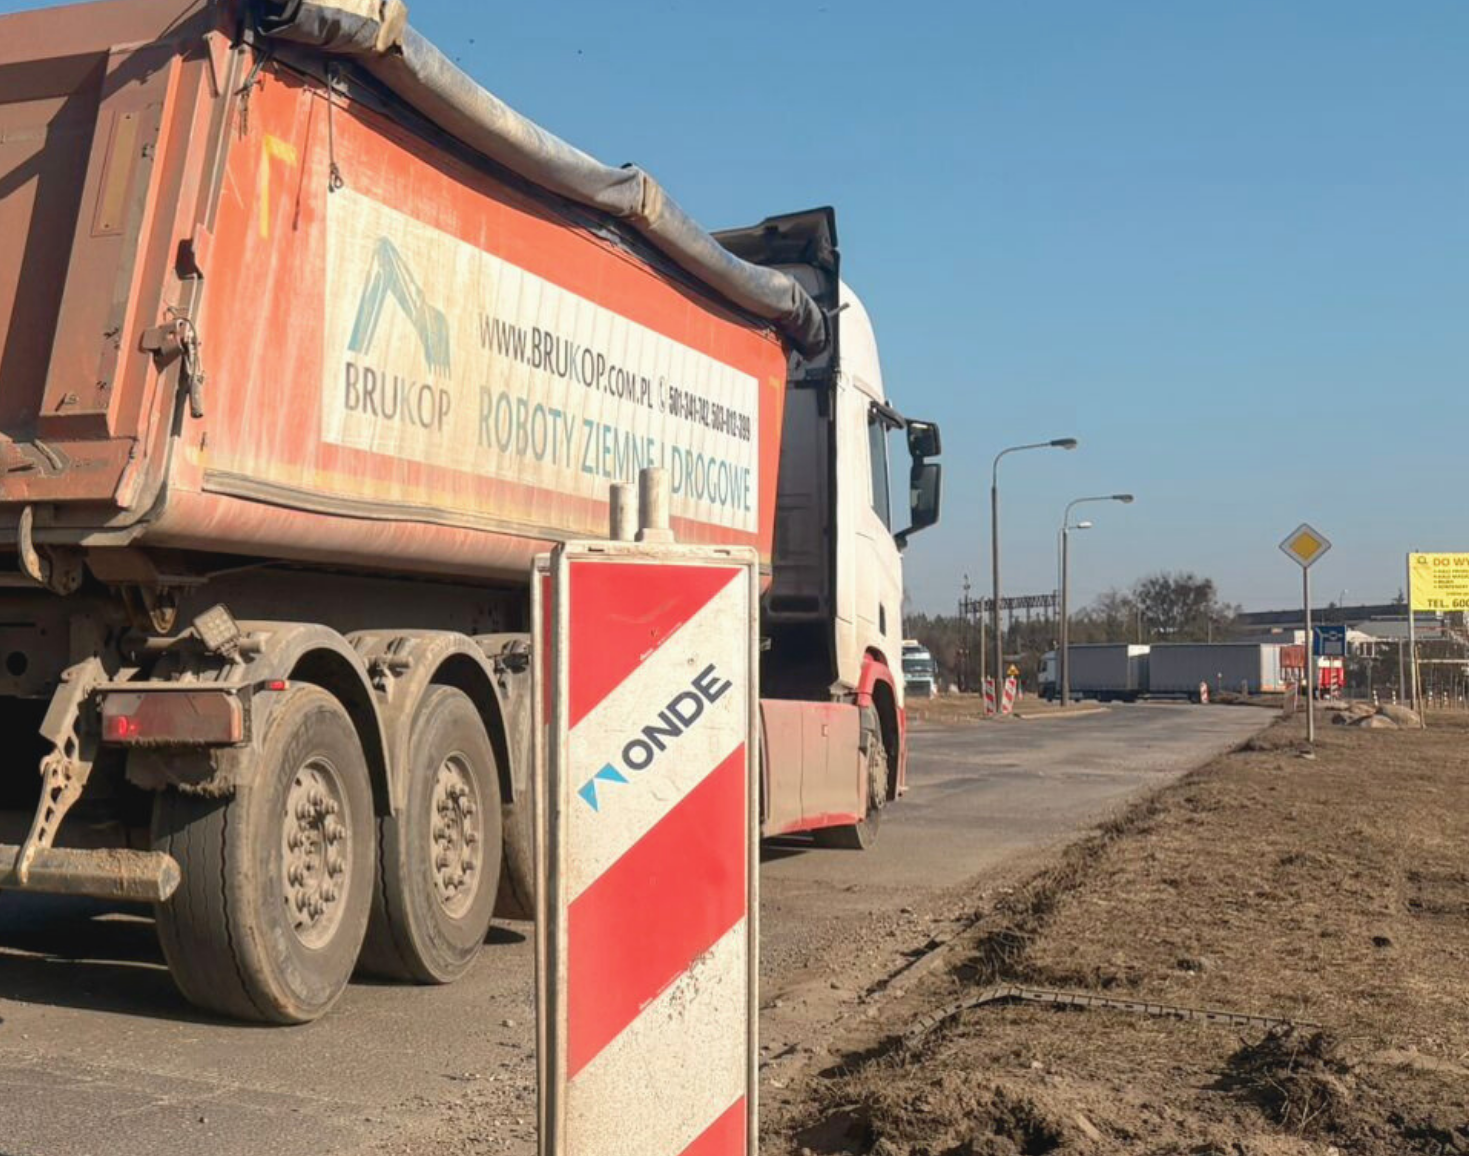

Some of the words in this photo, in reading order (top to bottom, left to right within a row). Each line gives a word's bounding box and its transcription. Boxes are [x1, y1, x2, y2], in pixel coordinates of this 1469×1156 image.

[344, 361, 451, 433] BRUKOP
[479, 312, 654, 409] WWW.BRUKOP.COM.PL
[478, 385, 575, 469] ROBOTY
[581, 418, 655, 484] ZIEMNE
[671, 445, 751, 512] DROGOWE
[1427, 598, 1449, 608] TEL.
[1433, 557, 1450, 566] DO
[621, 663, 733, 771] ONDE
